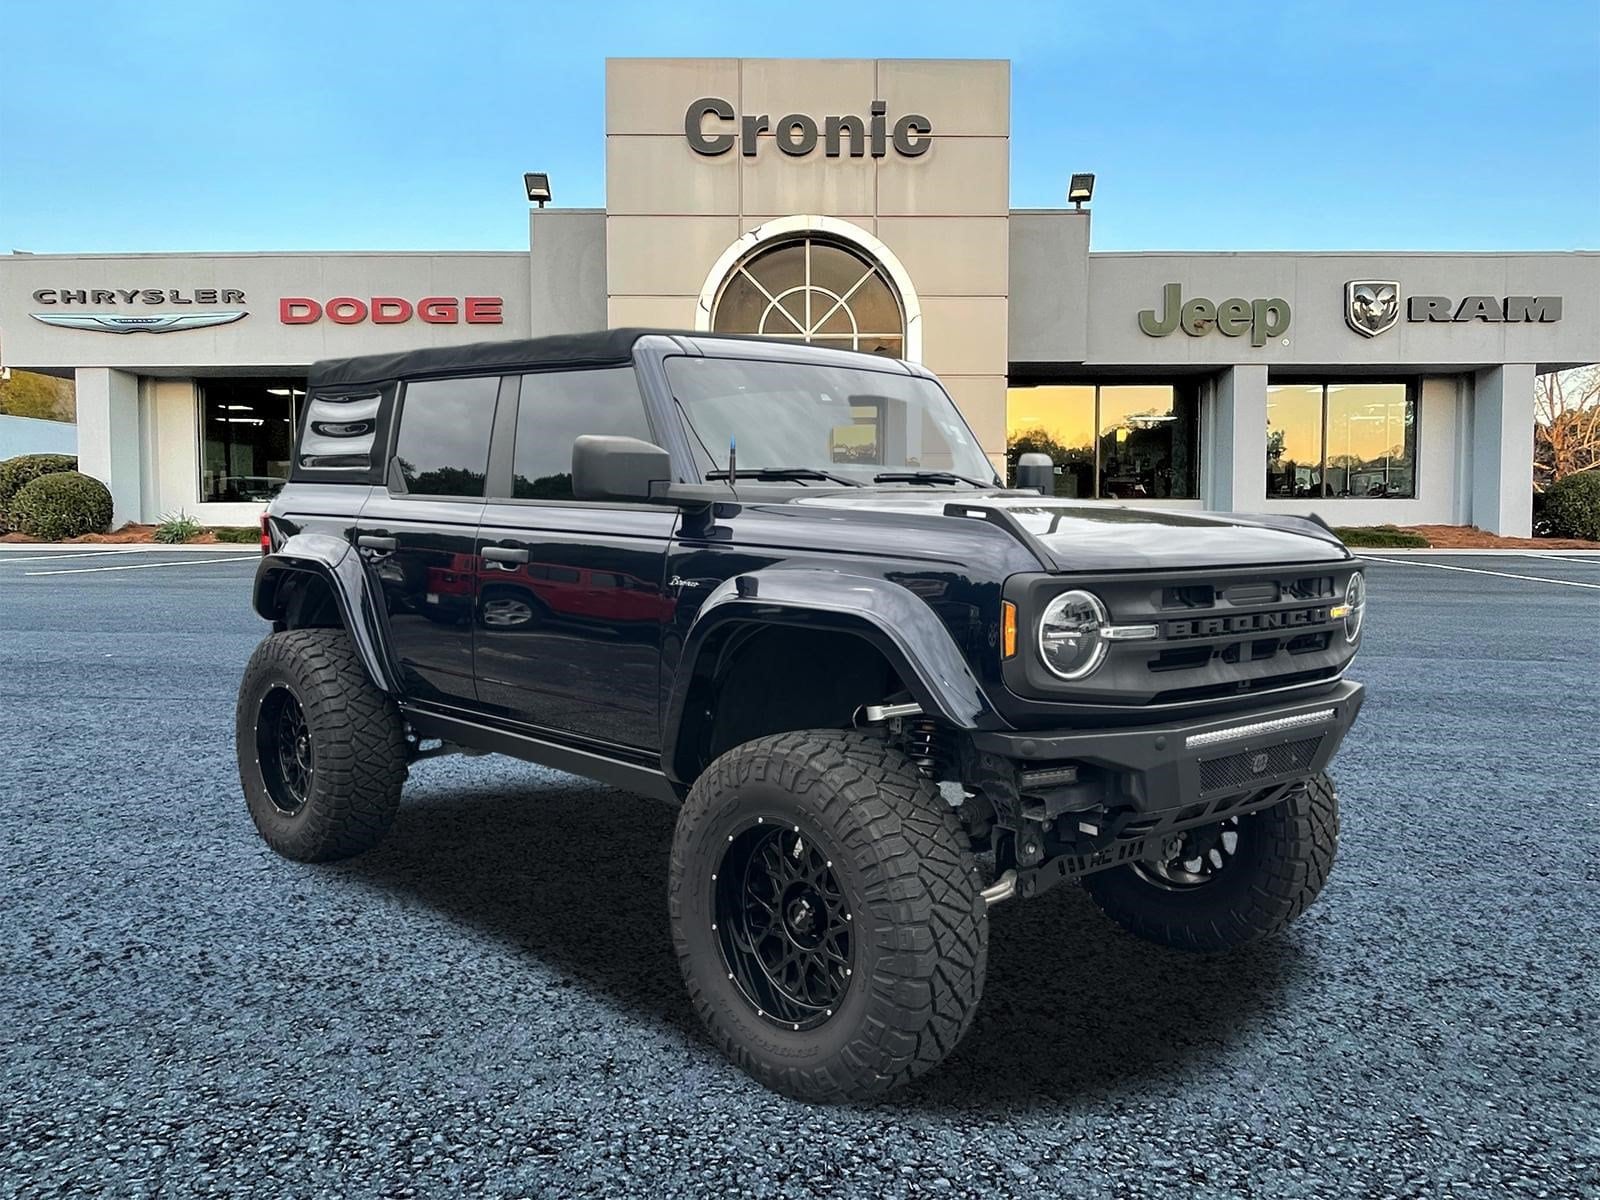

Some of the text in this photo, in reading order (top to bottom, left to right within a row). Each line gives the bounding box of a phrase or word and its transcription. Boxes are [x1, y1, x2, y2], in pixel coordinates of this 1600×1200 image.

[685, 97, 932, 157] Cronic
[32, 288, 246, 305] CHRYSLER
[280, 297, 504, 325] DODGE
[1407, 296, 1563, 323] RAM
[1138, 283, 1292, 347] Jeep
[1167, 609, 1328, 639] BRONCO
